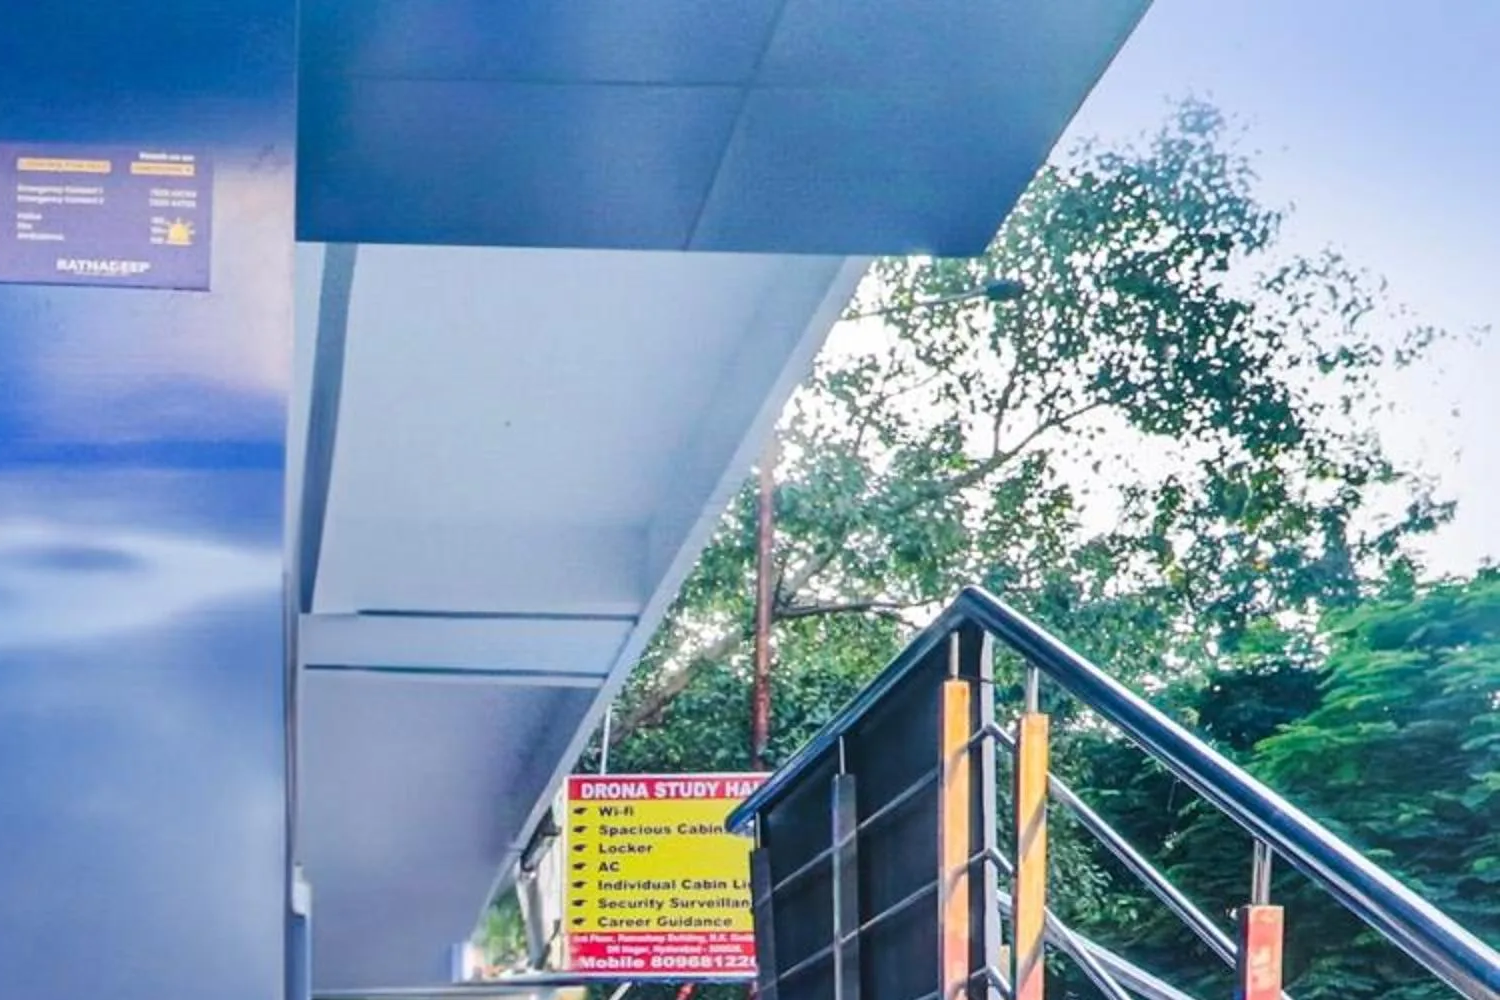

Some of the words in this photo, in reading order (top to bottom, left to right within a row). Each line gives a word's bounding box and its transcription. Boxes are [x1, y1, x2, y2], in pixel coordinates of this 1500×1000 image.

[56, 258, 150, 273] RATNADEEP
[580, 782, 649, 799] DRONA
[655, 782, 719, 799] STUDY
[598, 823, 672, 838] Spacious
[598, 843, 654, 855] Locker
[598, 861, 620, 873] AC
[598, 879, 677, 891] Individual
[681, 879, 728, 891] Cabin
[598, 898, 664, 911] Security
[598, 916, 651, 928] Career
[657, 916, 734, 928] Guidance
[579, 955, 646, 969] Mobile
